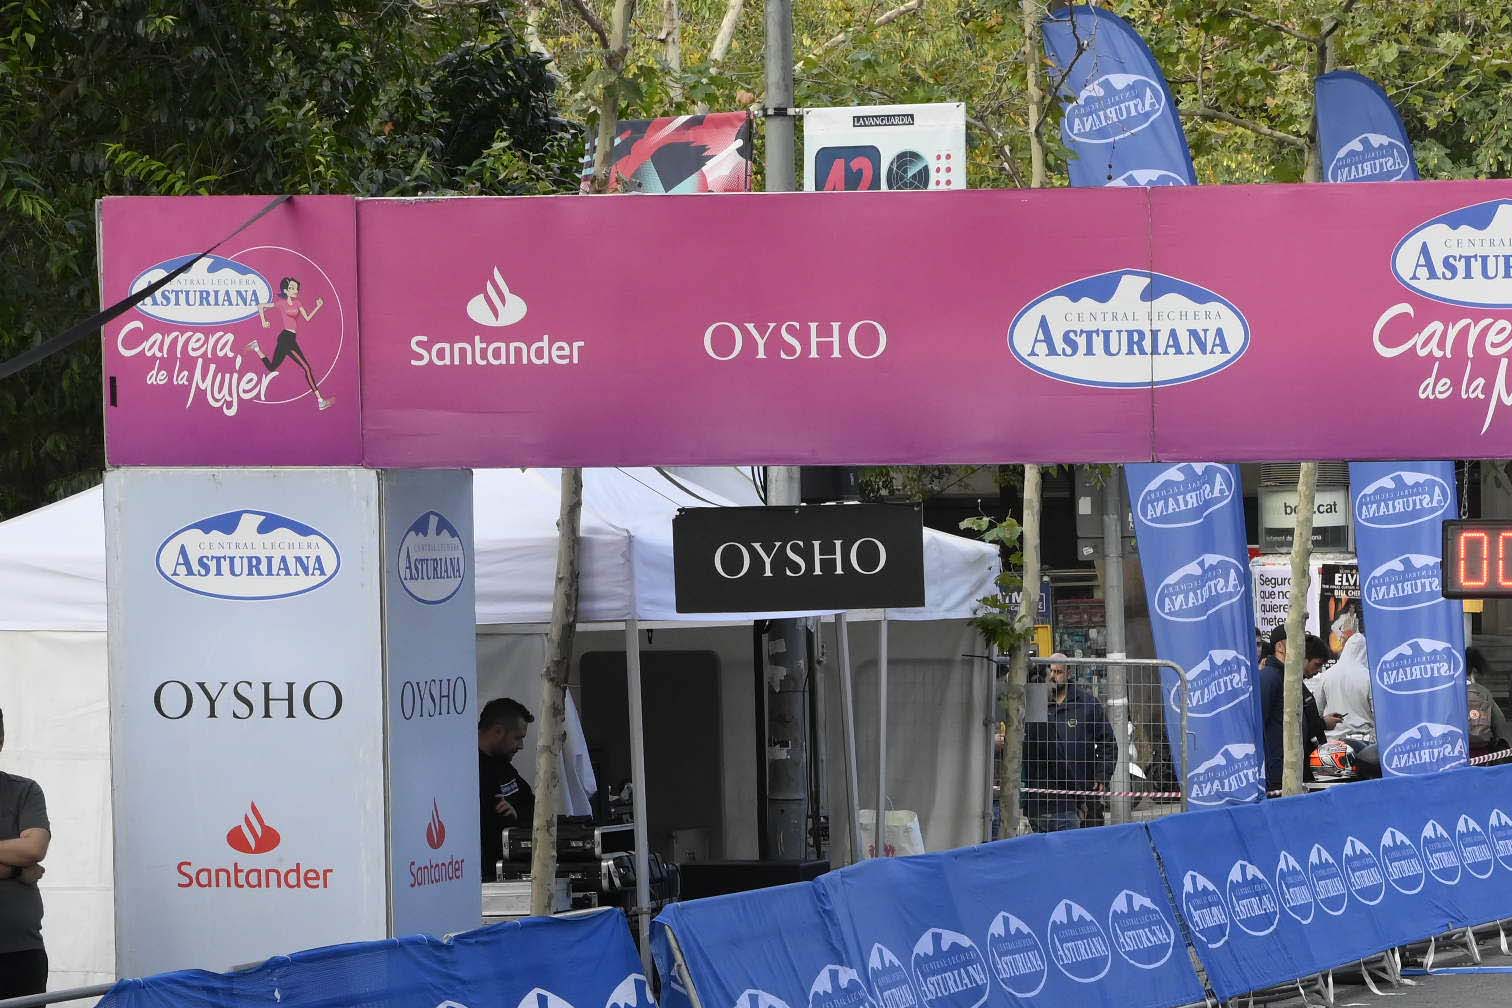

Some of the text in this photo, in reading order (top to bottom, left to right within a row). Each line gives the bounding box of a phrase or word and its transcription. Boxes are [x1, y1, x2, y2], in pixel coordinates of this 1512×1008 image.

[864, 115, 913, 126] VANGUARDIA
[169, 278, 207, 286] ENTRAL
[1064, 309, 1223, 322] CENTRAL LECHERA
[117, 320, 235, 359] Carrera
[410, 334, 584, 366] Santander
[703, 320, 888, 361] OYSHO
[1028, 314, 1231, 358] ASTURIANA
[147, 353, 279, 416] de la Mujer
[1418, 361, 1453, 400] de
[1461, 361, 1485, 400] la
[174, 543, 328, 578] ASTURIANA
[198, 541, 321, 551] CENTRAL LECHERA
[714, 537, 887, 580] OYSHO
[404, 547, 462, 581] ASTURIANA
[1334, 573, 1360, 586] ELVI
[1259, 591, 1276, 603] que
[154, 680, 343, 720] OYSHO
[400, 676, 467, 721] OYSHO
[178, 861, 333, 890] Santander
[409, 857, 465, 889] Santander
[992, 946, 1044, 979] ASTURIANA
[1054, 933, 1109, 965] ASTURIANA
[916, 962, 988, 1002] ASTURIANA
